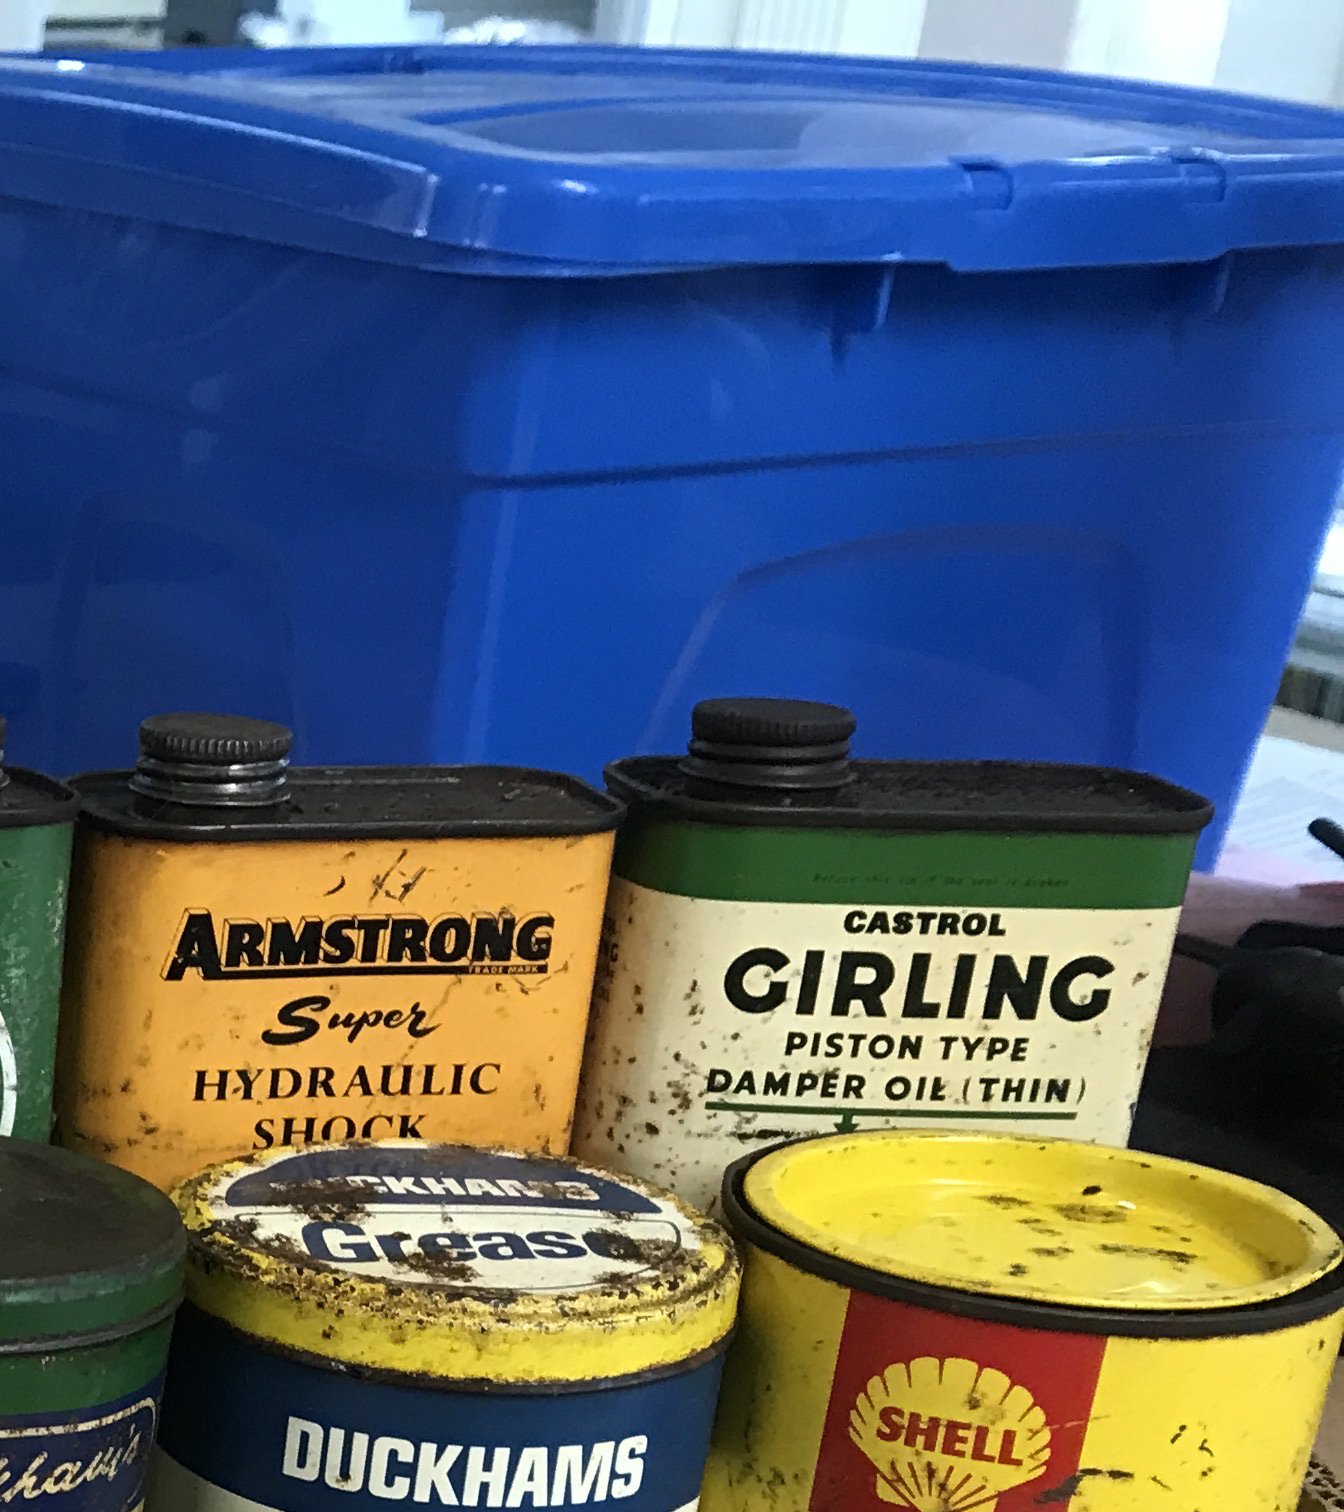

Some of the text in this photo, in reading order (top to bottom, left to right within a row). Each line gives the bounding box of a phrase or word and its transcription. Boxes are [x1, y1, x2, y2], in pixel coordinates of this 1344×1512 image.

[161, 905, 555, 981] ARMSTRONG
[843, 909, 1006, 937] CASTROL
[507, 964, 538, 974] MARK
[723, 946, 1116, 1023] GIRLING
[261, 995, 442, 1046] Super
[783, 1030, 1030, 1062] PISTON TYPE
[192, 1062, 502, 1102] HYDRAULIC
[705, 1067, 1088, 1107] DAMPER OIL (THIN)
[252, 1113, 428, 1150] SHOCK
[876, 1404, 1024, 1468] SHELL
[282, 1415, 650, 1510] DUCKHAMS
